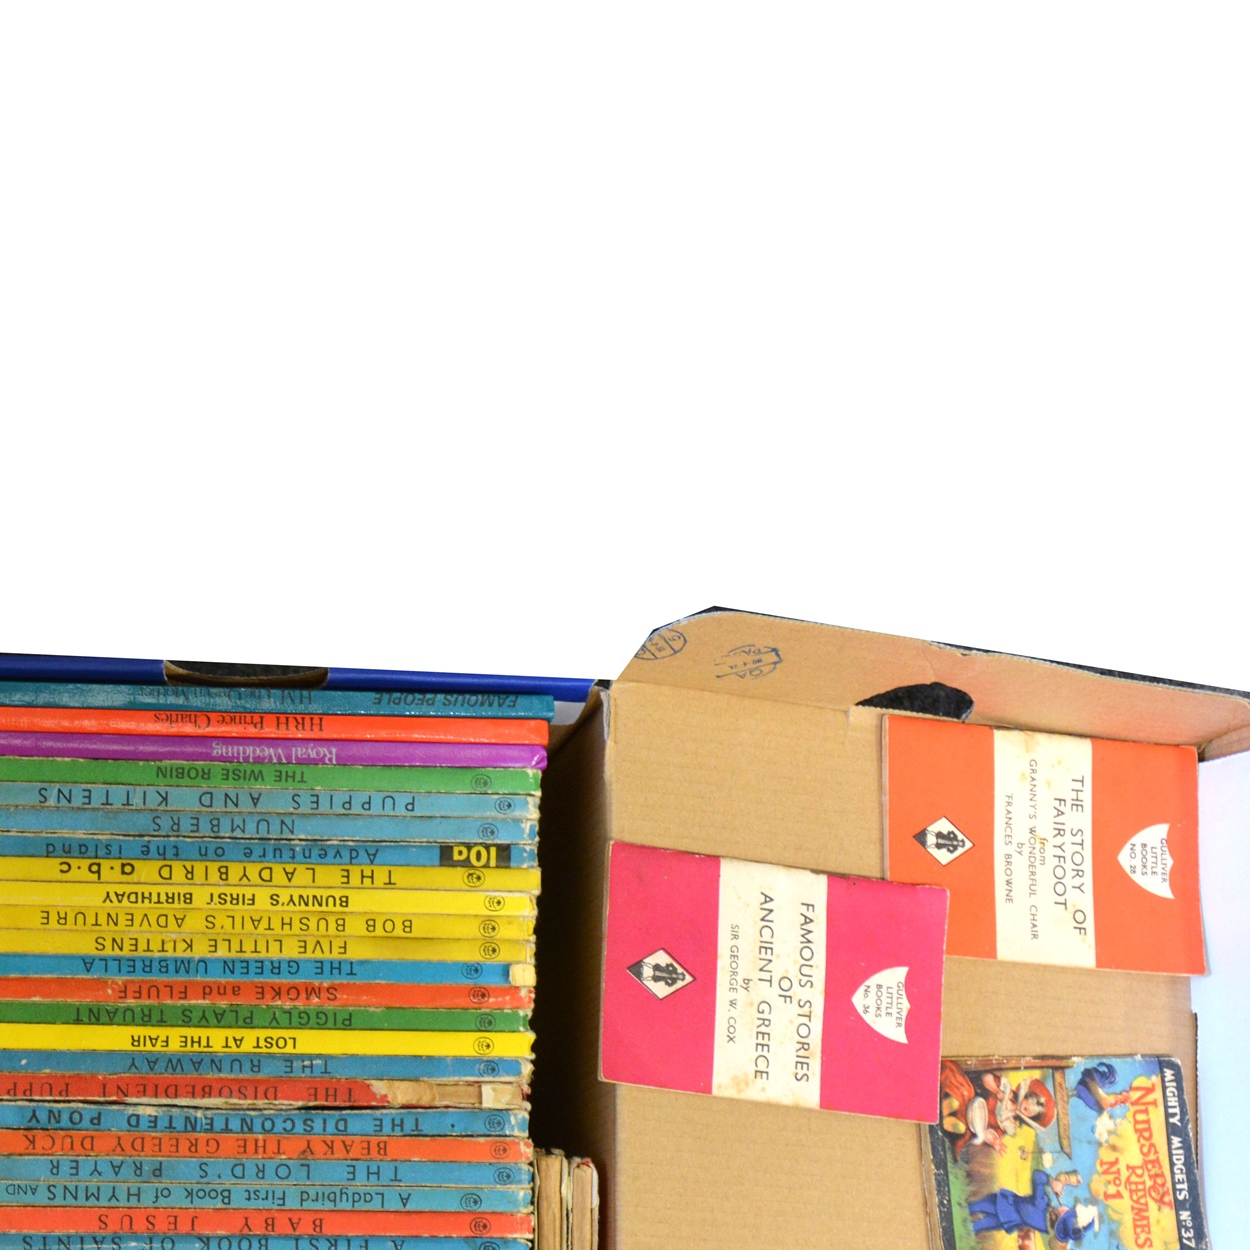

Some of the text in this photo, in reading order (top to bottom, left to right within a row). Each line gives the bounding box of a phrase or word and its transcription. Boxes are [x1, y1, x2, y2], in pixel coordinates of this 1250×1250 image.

[153, 712, 324, 732] HRH Prince Charles
[155, 766, 308, 784] THE WISE ROBIN
[35, 787, 416, 812] PUPPIES AND KITTENS
[151, 815, 295, 835] NUMBERS
[452, 845, 497, 866] 10a
[1004, 793, 1014, 904] FRANCES BROWNE
[1014, 842, 1025, 856] by
[1028, 759, 1039, 941] GRANNY'S WONDERFUL CHAIR
[1039, 837, 1048, 866] from
[1051, 797, 1068, 911] FAIRYFOOT
[1070, 776, 1087, 936] THE STORY OF
[102, 890, 350, 909] BUNNY'S FIRST BIRTHDAY
[94, 936, 348, 955] FIVE LITTLE KITTENS
[727, 924, 740, 1044] SIR GEORGE W. COX
[741, 977, 753, 992] by
[753, 892, 775, 1081] ANCIENT GREECE
[778, 976, 794, 1005] OF
[794, 902, 815, 1083] FAMOUS STORIES
[130, 1034, 297, 1050] LOST AT THE FAIR
[1163, 1069, 1180, 1125] MIGHTY
[1126, 1083, 1173, 1249] NURSERY RHYMES
[1170, 1136, 1188, 1200] MIDGETS
[97, 1214, 325, 1235] BABY JESUS
